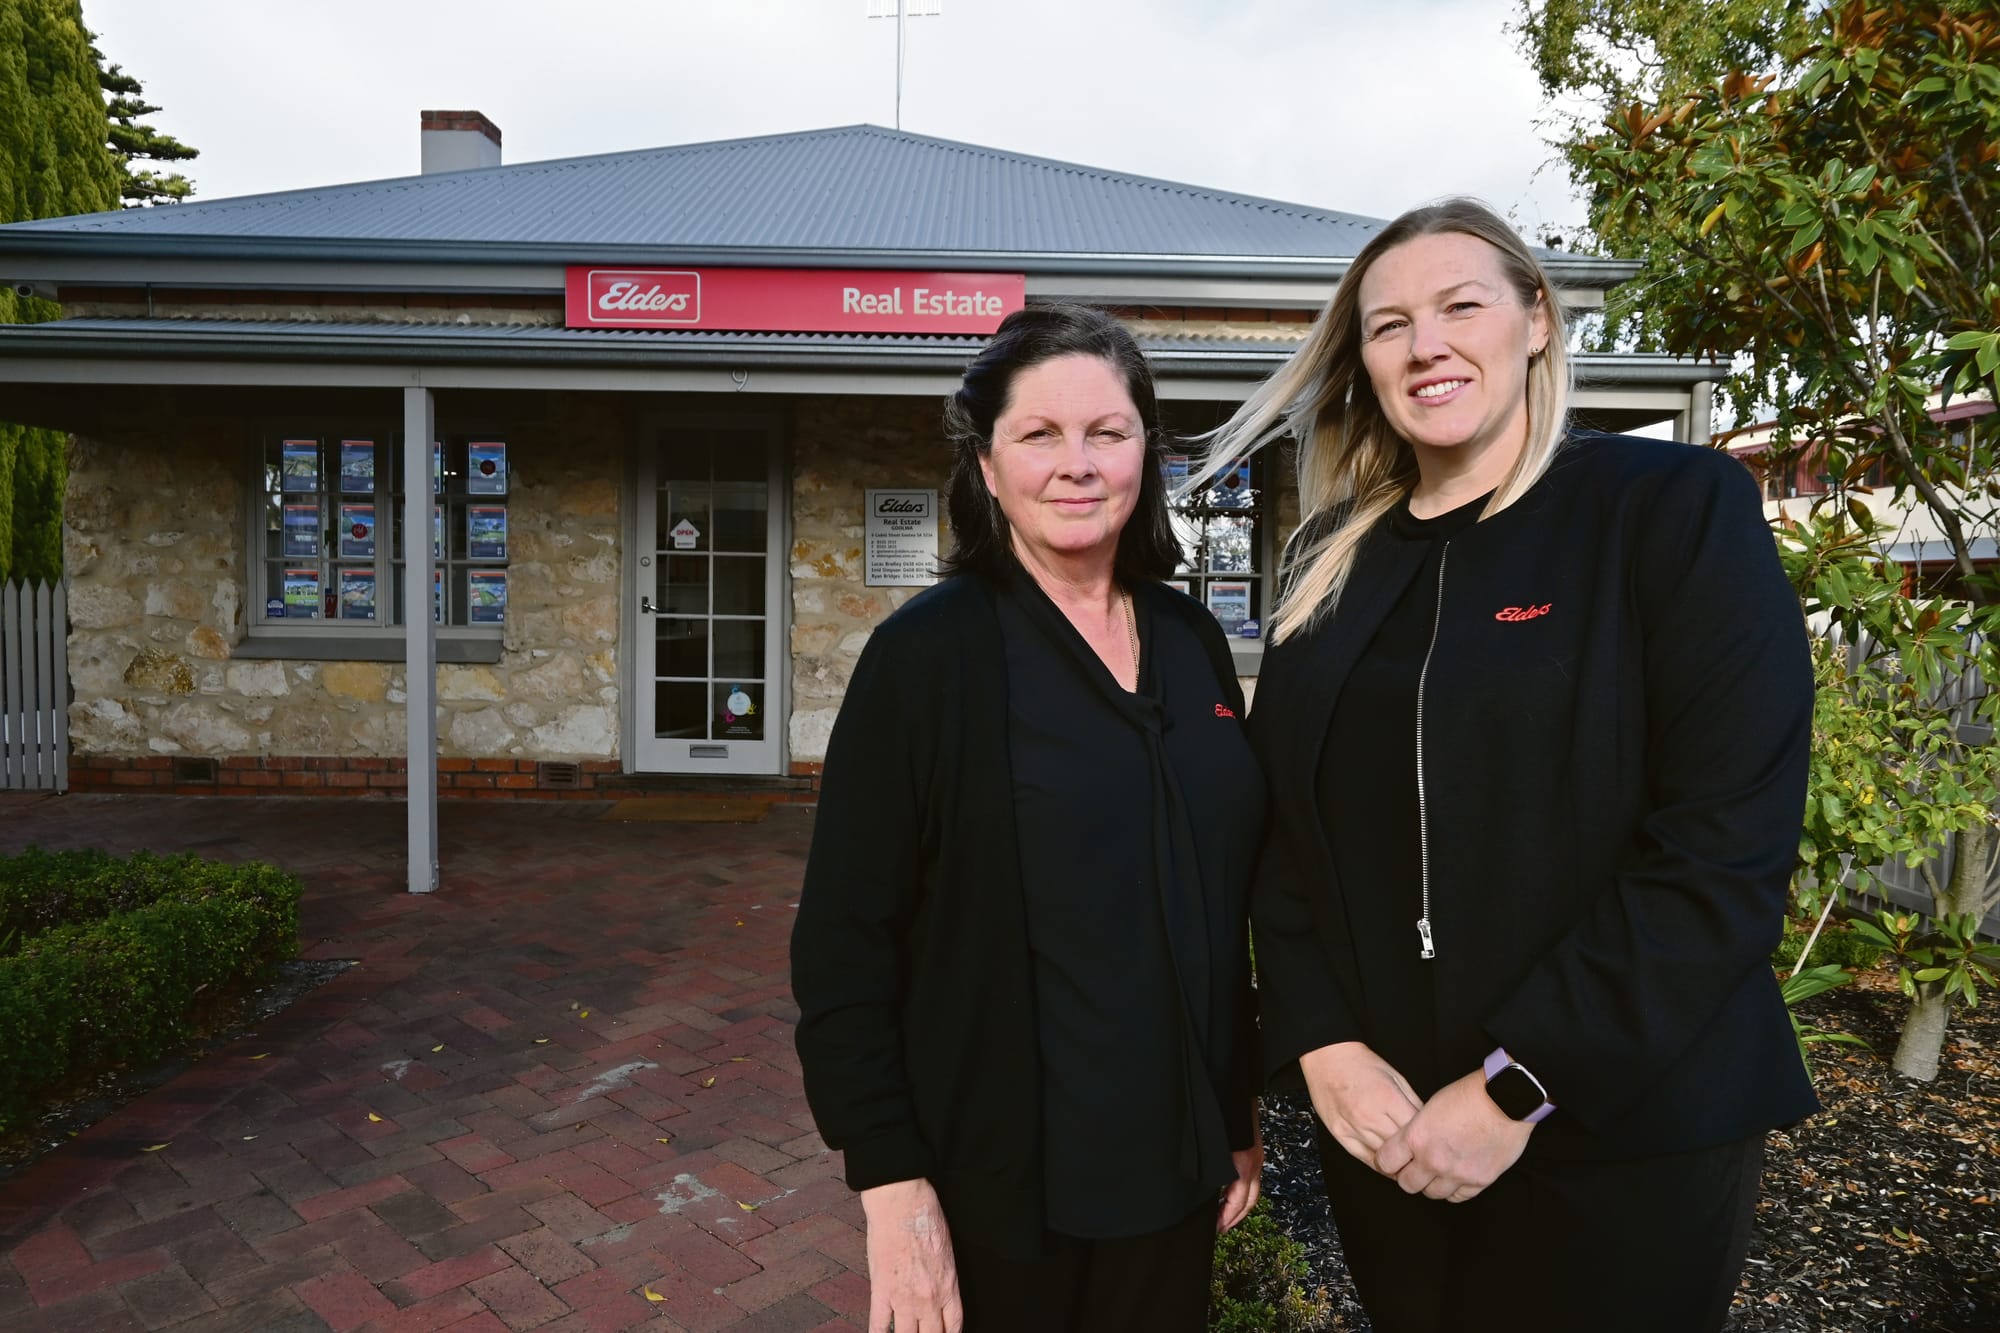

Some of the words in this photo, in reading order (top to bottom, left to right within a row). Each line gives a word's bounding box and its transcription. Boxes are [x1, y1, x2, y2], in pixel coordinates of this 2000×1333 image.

[598, 281, 691, 311] Elders
[843, 287, 903, 315] Real
[913, 288, 1003, 317] Estate
[731, 368, 749, 391] 9
[879, 498, 925, 513] Elders
[883, 518, 898, 526] Real
[900, 518, 922, 526] Estate
